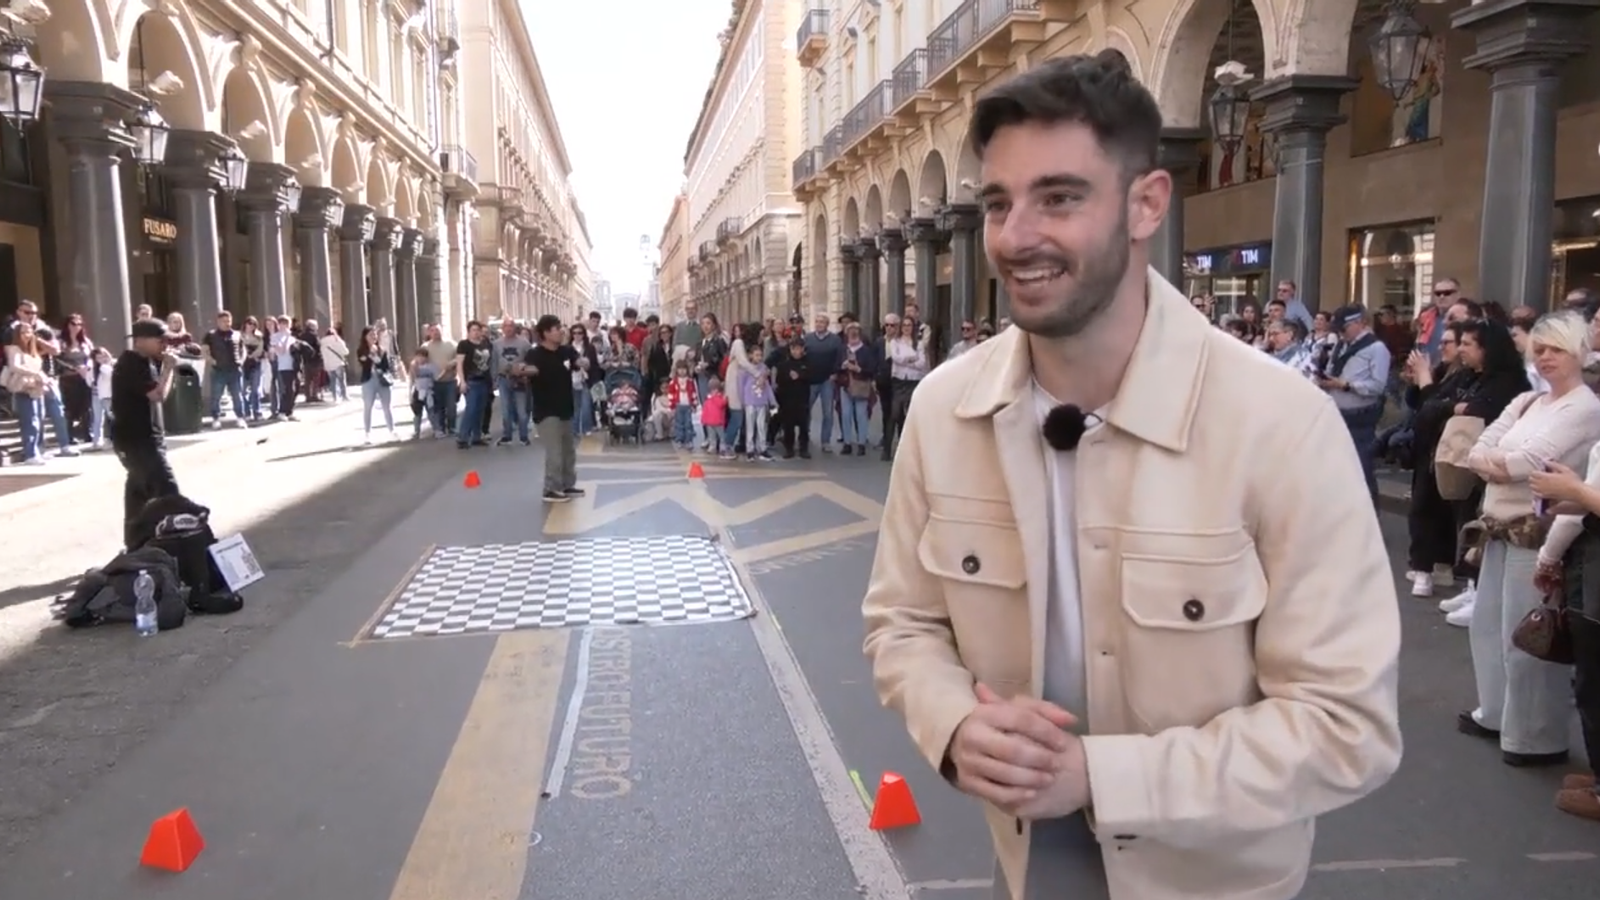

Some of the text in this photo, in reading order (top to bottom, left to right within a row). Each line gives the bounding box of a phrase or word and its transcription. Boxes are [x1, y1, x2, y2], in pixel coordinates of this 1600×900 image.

[144, 218, 177, 239] FUSARO
[1197, 255, 1212, 269] TIM
[1241, 249, 1258, 264] TIM
